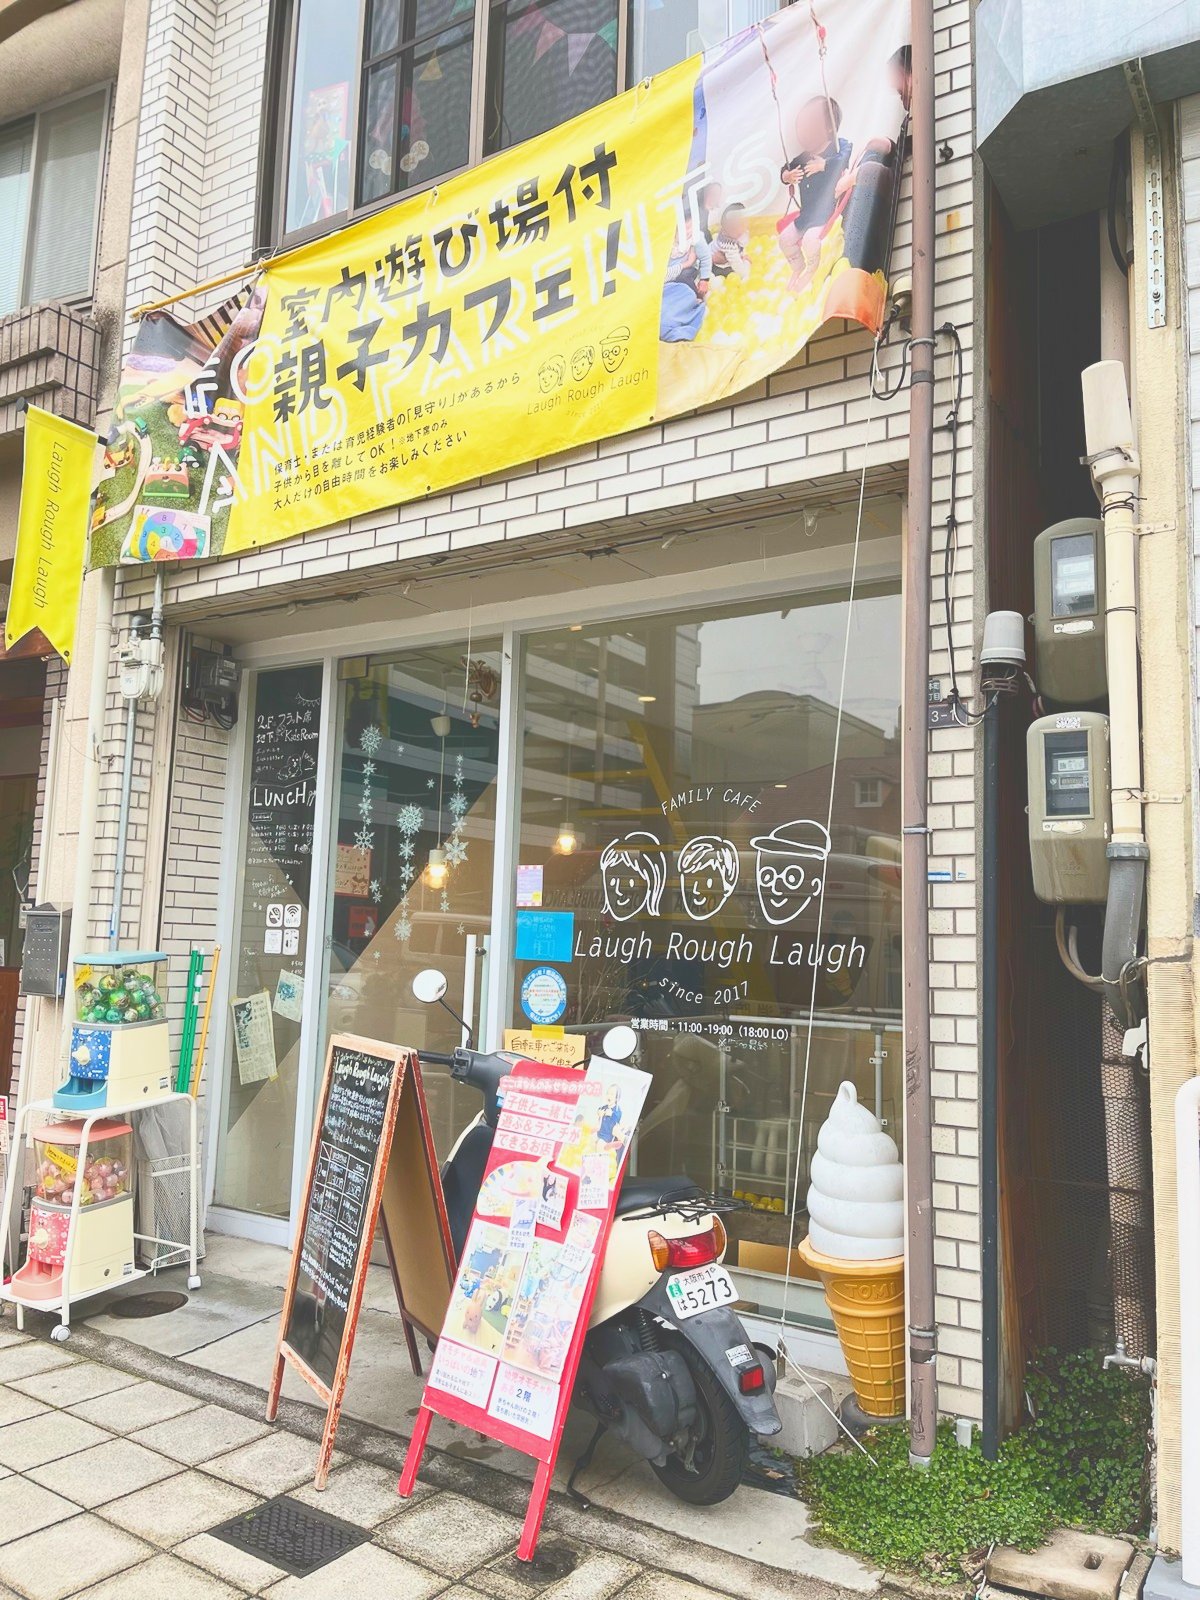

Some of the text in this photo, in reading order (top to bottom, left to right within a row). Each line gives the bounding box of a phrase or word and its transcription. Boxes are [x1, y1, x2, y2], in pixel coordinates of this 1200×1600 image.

[280, 141, 618, 344] 室内遊び場付
[527, 395, 562, 415] Laugh
[567, 381, 605, 403] Rough
[610, 368, 649, 390] Laugh
[33, 441, 68, 609] Laugh Rough Laugh
[253, 781, 307, 807] LUNCH
[661, 786, 762, 816] FAMILY CAFE
[574, 929, 653, 964] Laugh
[666, 931, 753, 968] Rough
[769, 935, 866, 973] Laugh
[659, 976, 750, 1005] since 2017
[508, 1094, 574, 1120] 子供と一緒に
[499, 1133, 552, 1156] できるお店
[682, 1272, 705, 1286] 大阪市
[677, 1298, 688, 1312] は
[686, 1277, 732, 1309] 5273
